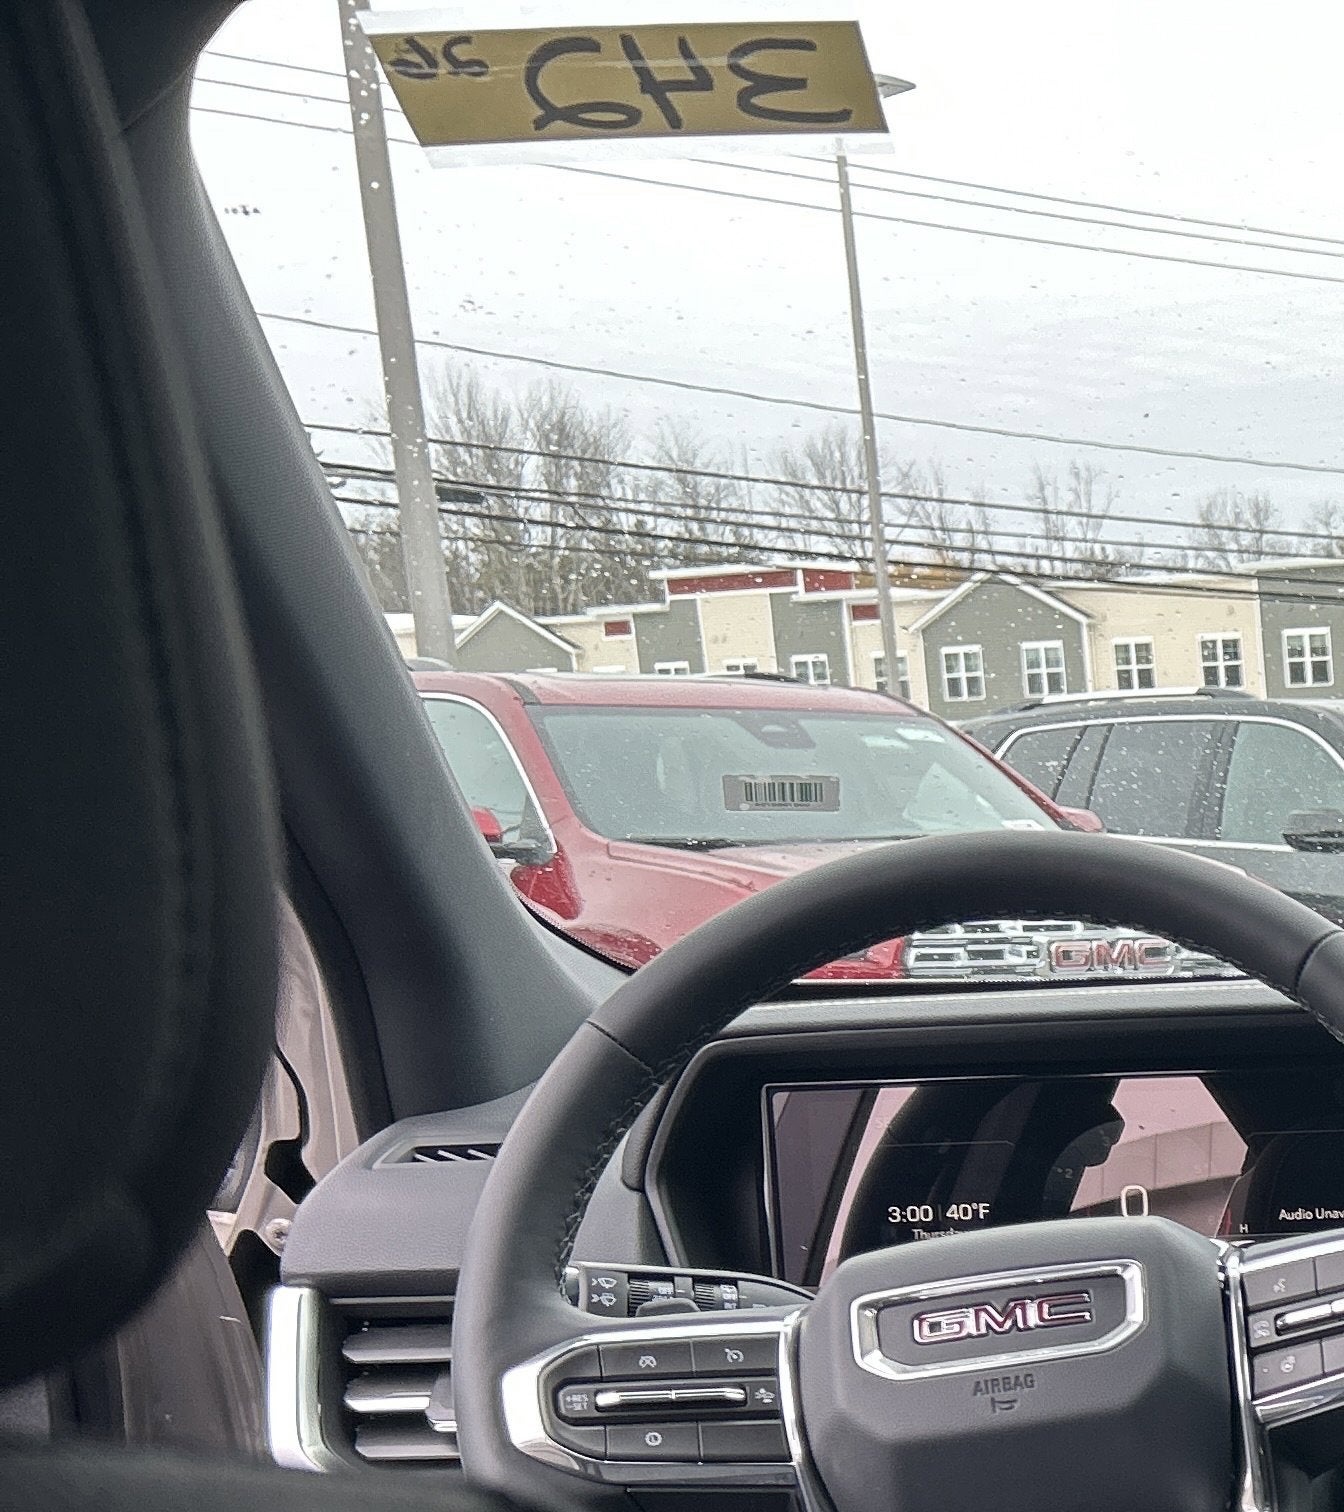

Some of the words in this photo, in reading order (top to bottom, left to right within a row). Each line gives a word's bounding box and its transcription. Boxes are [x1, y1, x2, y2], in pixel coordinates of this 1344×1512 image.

[1050, 939, 1173, 974] GMC
[888, 1205, 933, 1223] 3:00
[946, 1202, 990, 1220] 40°F
[1278, 1208, 1313, 1221] Audio
[1239, 1223, 1249, 1234] H
[913, 1292, 1093, 1345] GMC
[972, 1373, 1035, 1396] AIRBAG
